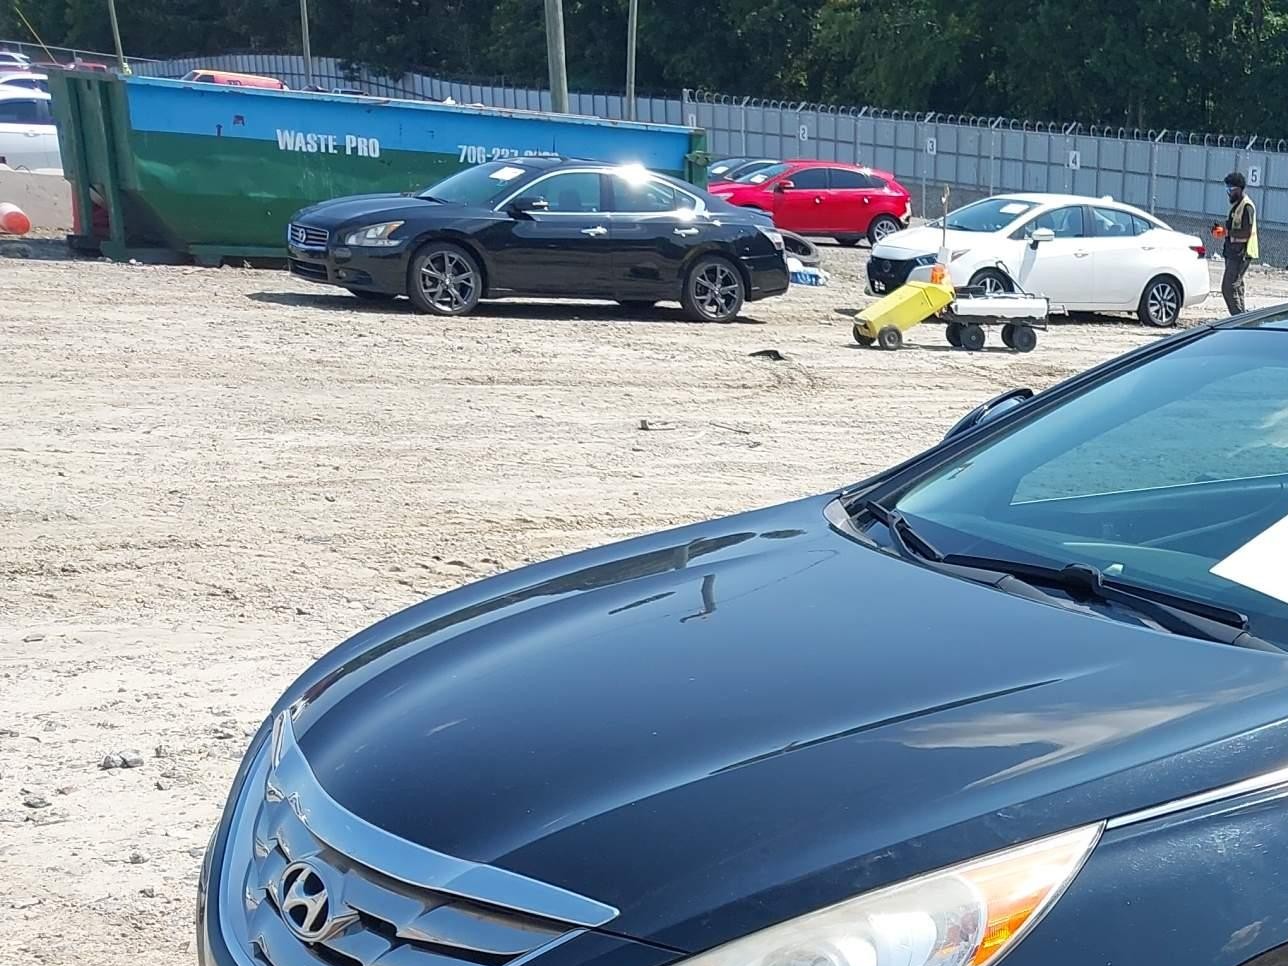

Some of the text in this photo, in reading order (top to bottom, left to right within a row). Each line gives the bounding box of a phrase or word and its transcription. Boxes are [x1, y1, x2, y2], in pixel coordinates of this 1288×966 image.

[276, 129, 380, 158] WASTE PRO
[1250, 169, 1257, 182] 5
